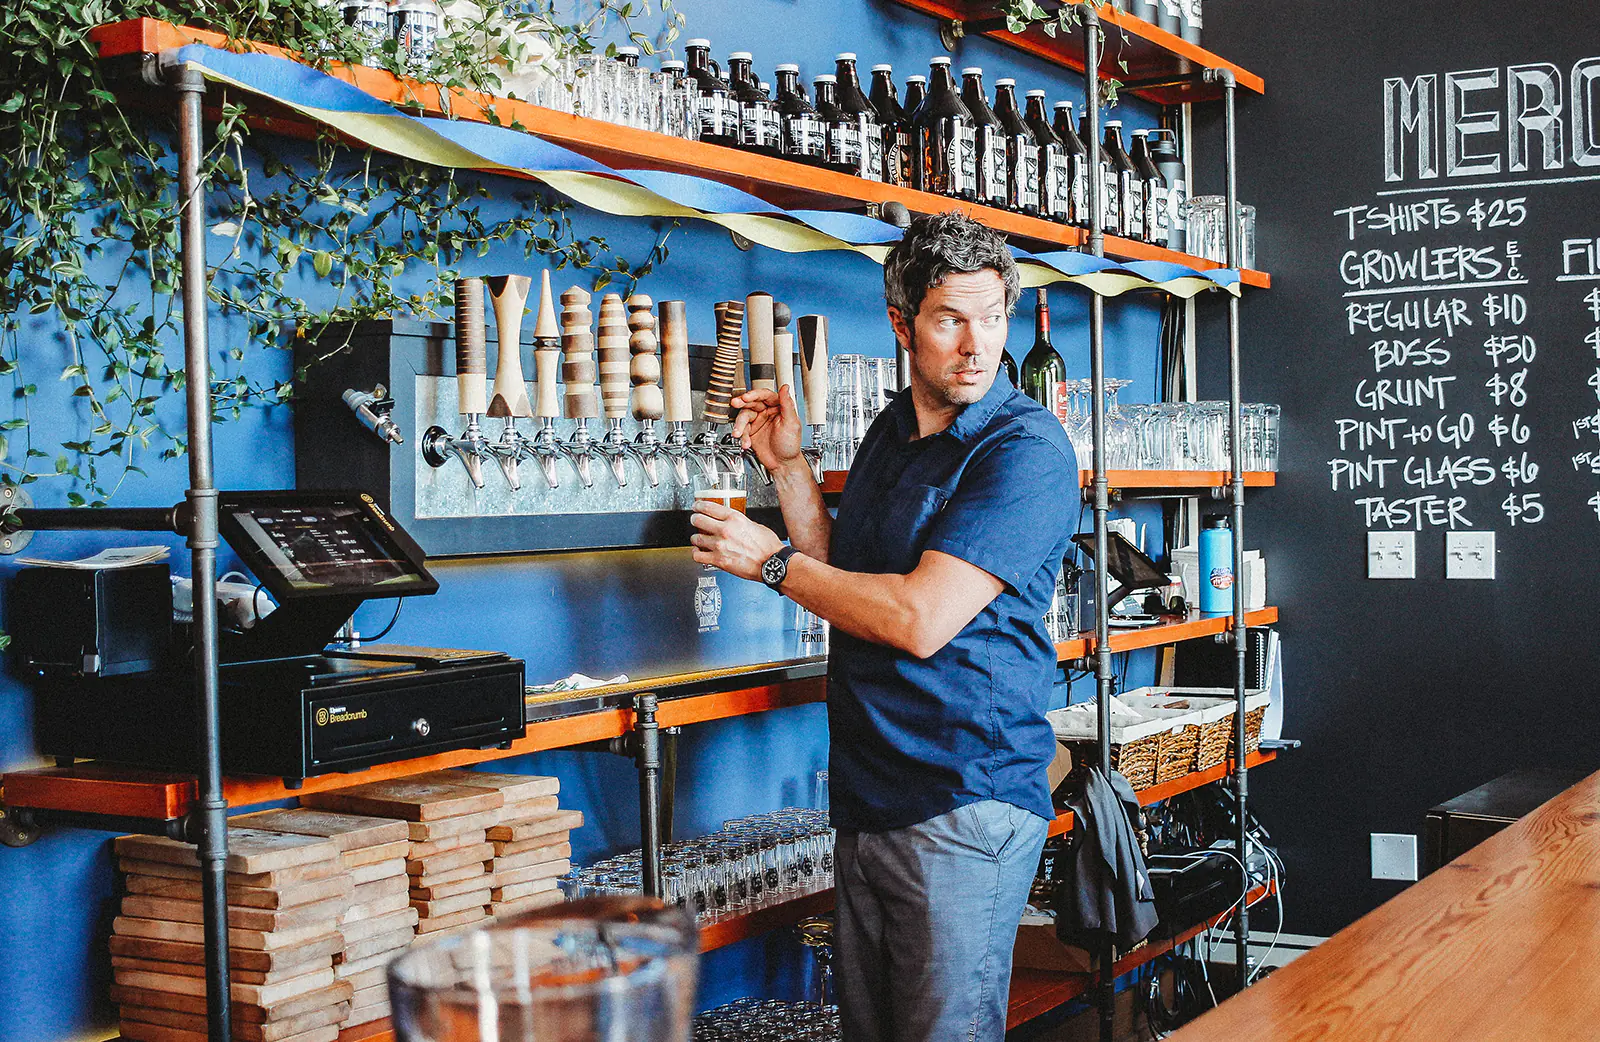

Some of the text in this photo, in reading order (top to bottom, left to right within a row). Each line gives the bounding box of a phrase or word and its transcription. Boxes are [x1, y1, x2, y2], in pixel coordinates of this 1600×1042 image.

[1333, 197, 1527, 240] T-SHIRTS $25
[1340, 245, 1502, 288] GROWLERS
[1345, 293, 1527, 337] REGULAR $10
[1368, 334, 1536, 372] BOSS $50
[1355, 368, 1528, 410] GRUNT $8
[1334, 417, 1407, 451] PINT
[1437, 413, 1475, 449] GO
[1488, 414, 1531, 447] $6
[1327, 451, 1539, 491] PINT GLASS $6
[1355, 492, 1545, 531] TASTER $5
[330, 709, 368, 724] Breadcrumb
